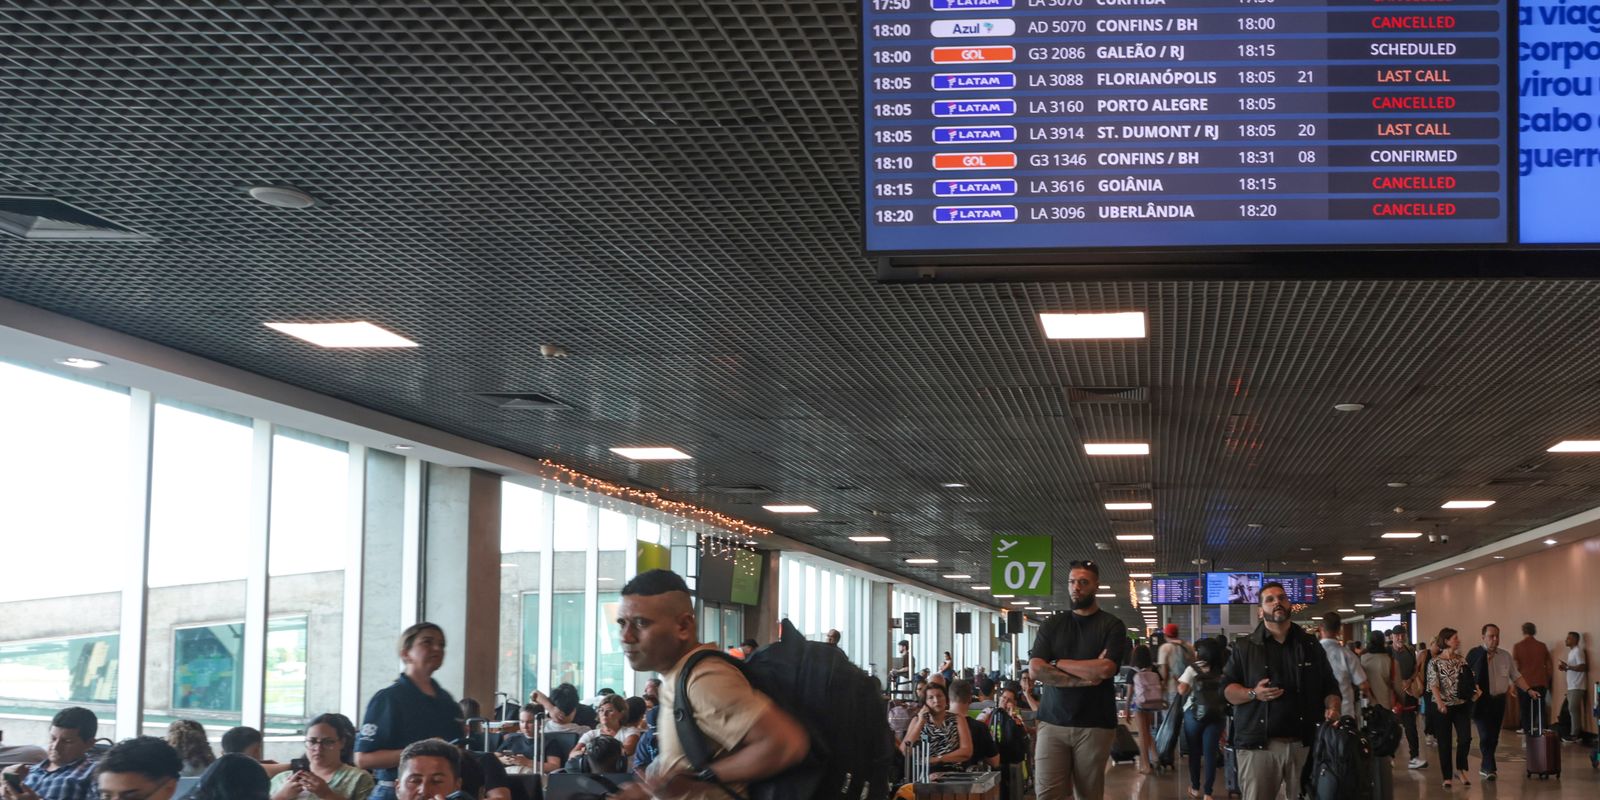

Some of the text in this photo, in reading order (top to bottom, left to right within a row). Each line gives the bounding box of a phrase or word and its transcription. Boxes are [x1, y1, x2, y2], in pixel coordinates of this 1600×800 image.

[873, 0, 911, 10] 17:50
[873, 16, 1456, 37] 18:00 Azul AD 5070 CONFINS / BH 18:00 CANCELLED
[873, 43, 1457, 64] 18:00 GOL G3 2086 GALEÃO / RJ 18:15 SCHEDULED
[873, 69, 1451, 90] 18:05 LATAM LA 3088 FLORIANÓPOLIS 18:05 21 LAST CALL
[874, 97, 1456, 117] 18:05 LATAM LA 3160 PORTO ALEGRE 18:05 CANCELLED
[874, 124, 1451, 143] 18:05 LATAM LA 3914 ST. DUMONT / RJ 18:05 20 LAST CALL
[874, 150, 1458, 170] 18:10 GOL G3 1346 CONFINS / BH 18:31 08 CONFIRMED
[1520, 148, 1600, 176] guerr
[875, 176, 1457, 196] 18:15 LATAM LA 3616 GOIÂNIA 18:15 CANCELLED
[875, 203, 1457, 223] 18:20 LATAM LA 3096 UBERLÂNDIA 18:20 CANCELLED
[1005, 561, 1046, 590] 07
